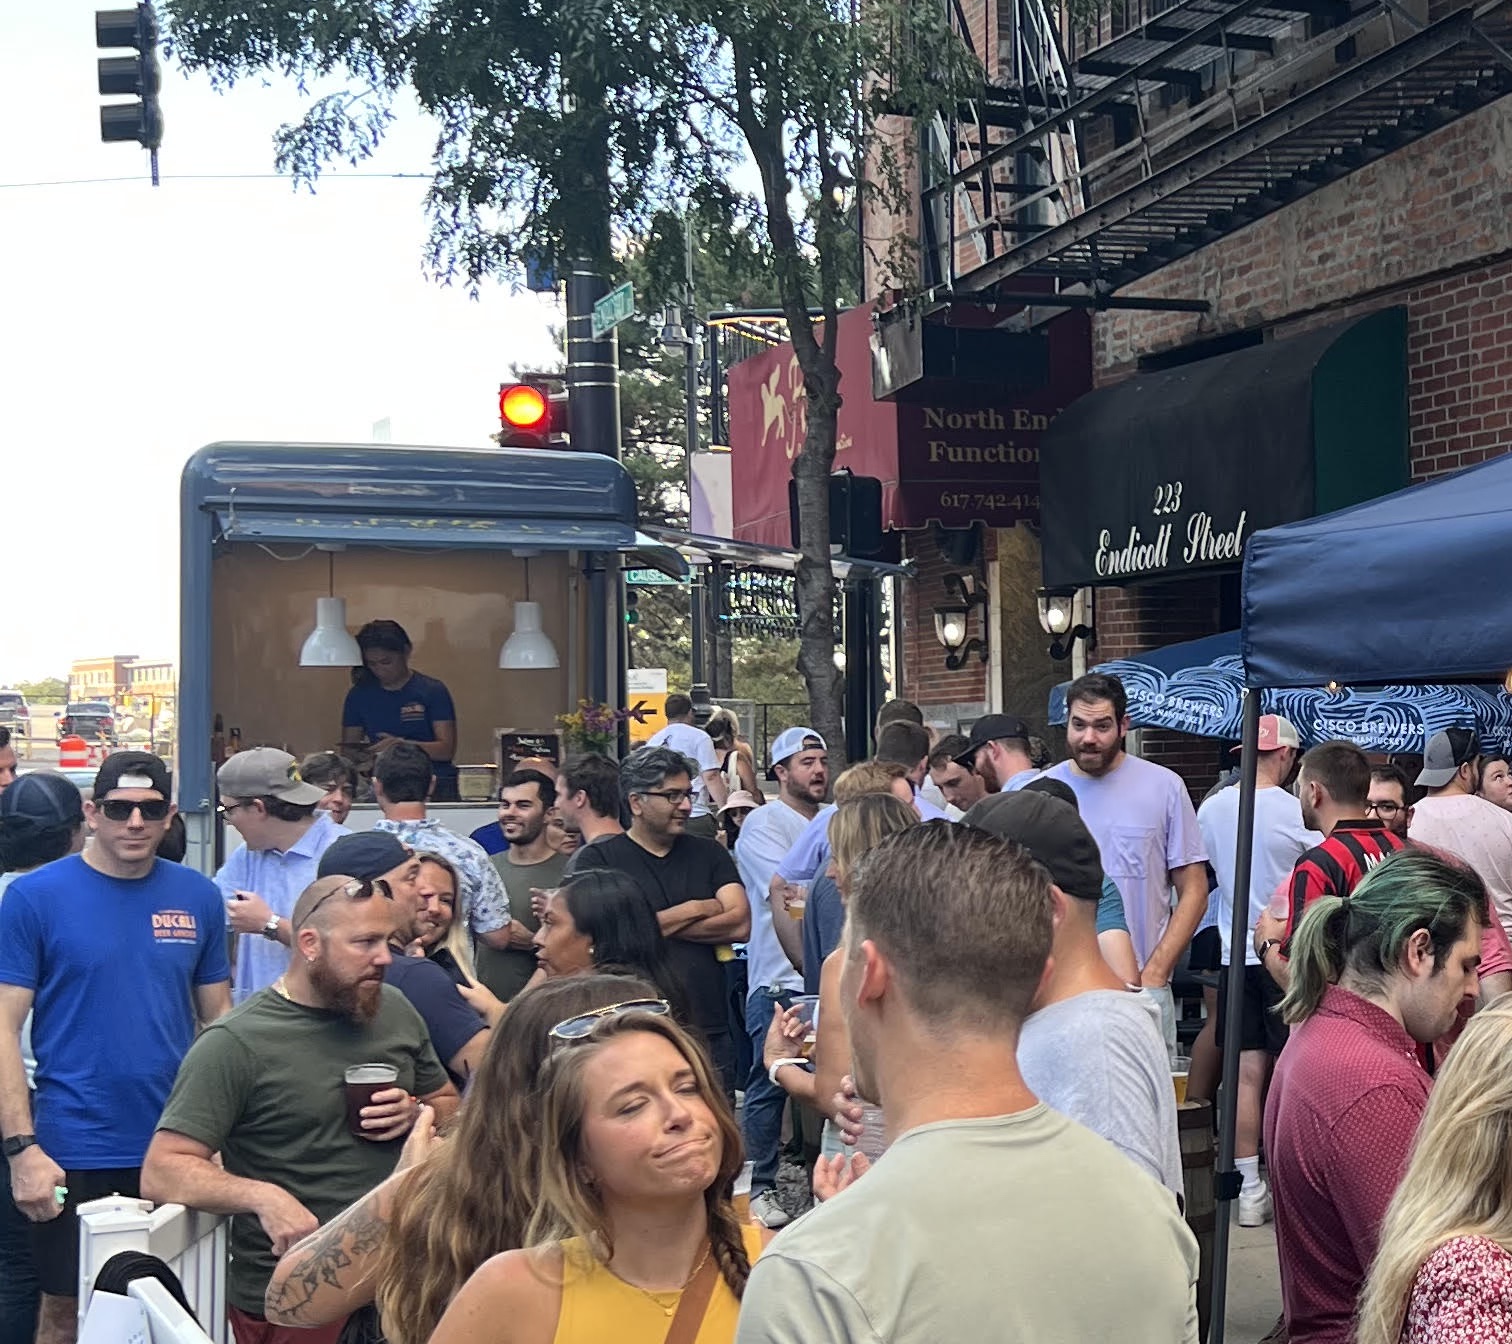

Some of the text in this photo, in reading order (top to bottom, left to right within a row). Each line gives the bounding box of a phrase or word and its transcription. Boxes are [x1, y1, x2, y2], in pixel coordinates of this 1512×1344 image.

[922, 407, 1005, 431] North
[1153, 481, 1183, 516] 223
[1094, 510, 1247, 577] Endicott Street
[1126, 687, 1225, 718] CISCO BREWERS
[1313, 718, 1425, 735] CISCO BREWERS
